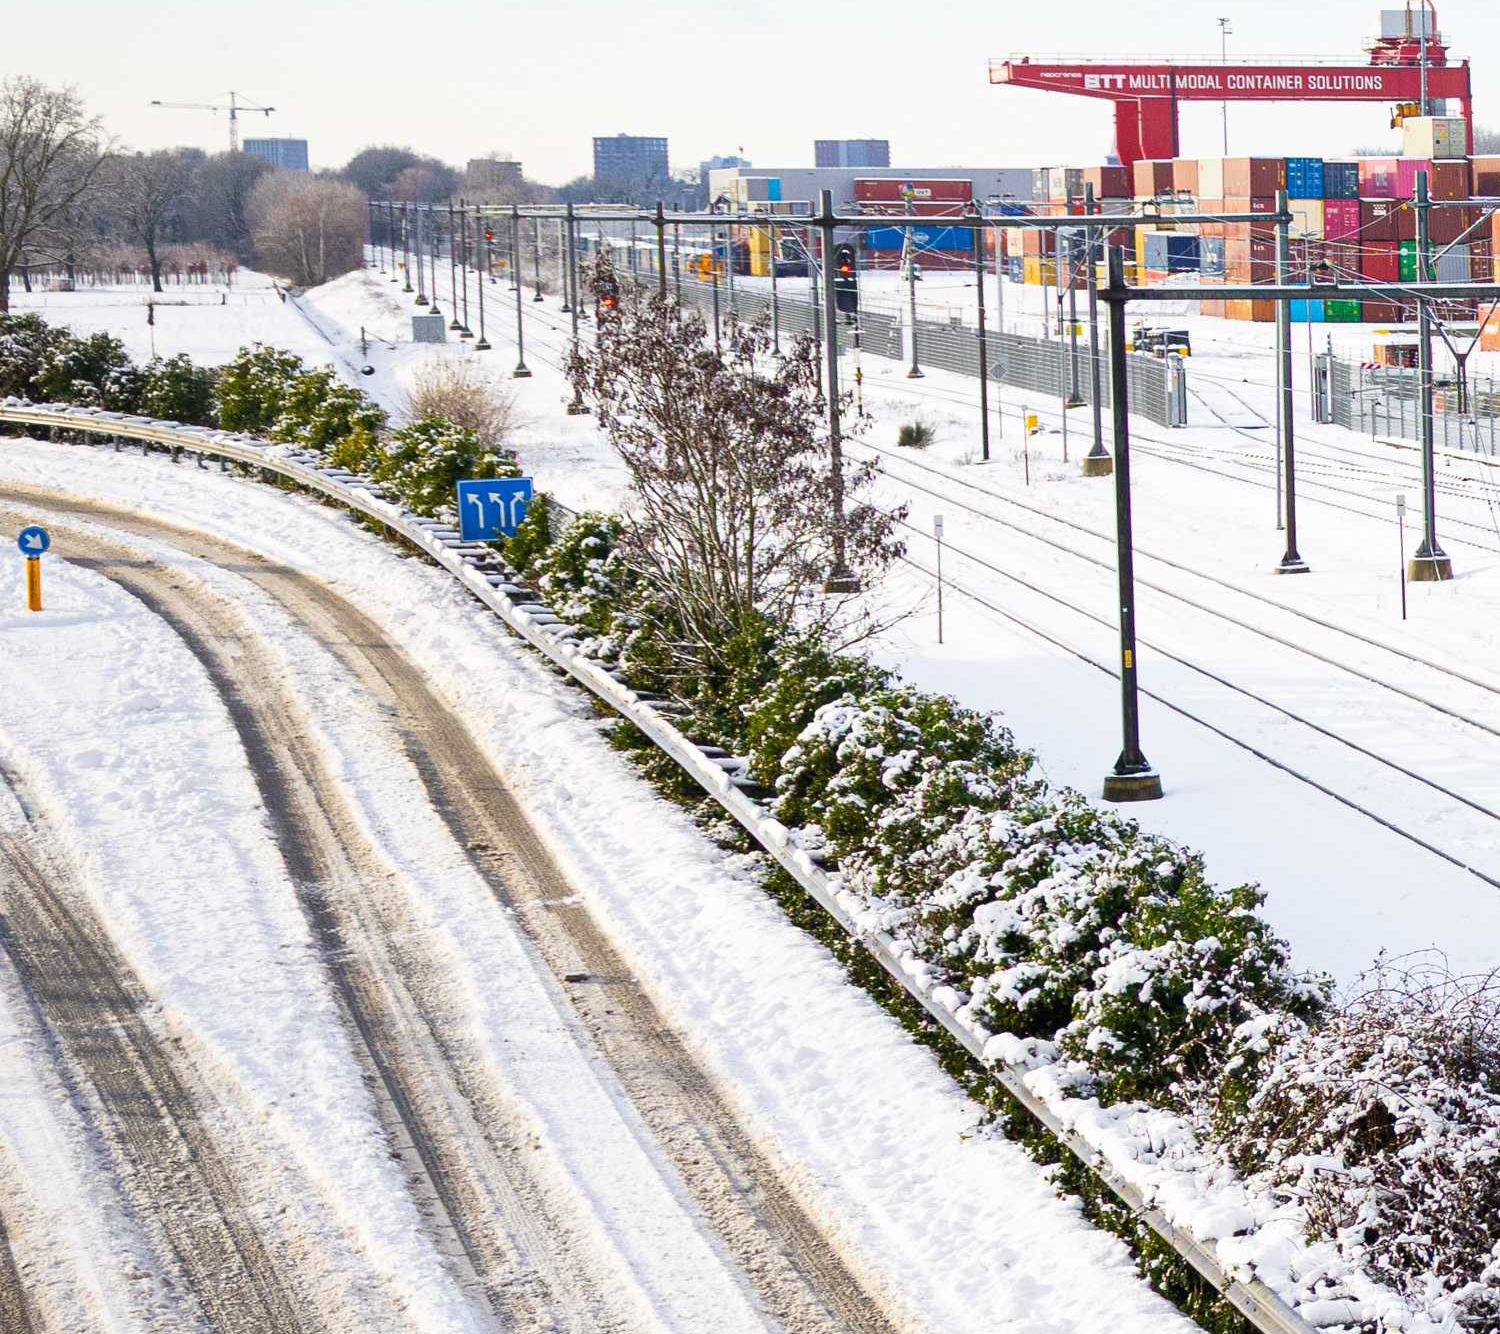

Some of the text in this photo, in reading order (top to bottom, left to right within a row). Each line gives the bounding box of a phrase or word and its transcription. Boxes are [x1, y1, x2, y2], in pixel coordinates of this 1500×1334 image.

[1084, 74, 1127, 89] BTT
[1227, 74, 1303, 90] CONTAINER
[1308, 74, 1383, 91] SOLUTIONS
